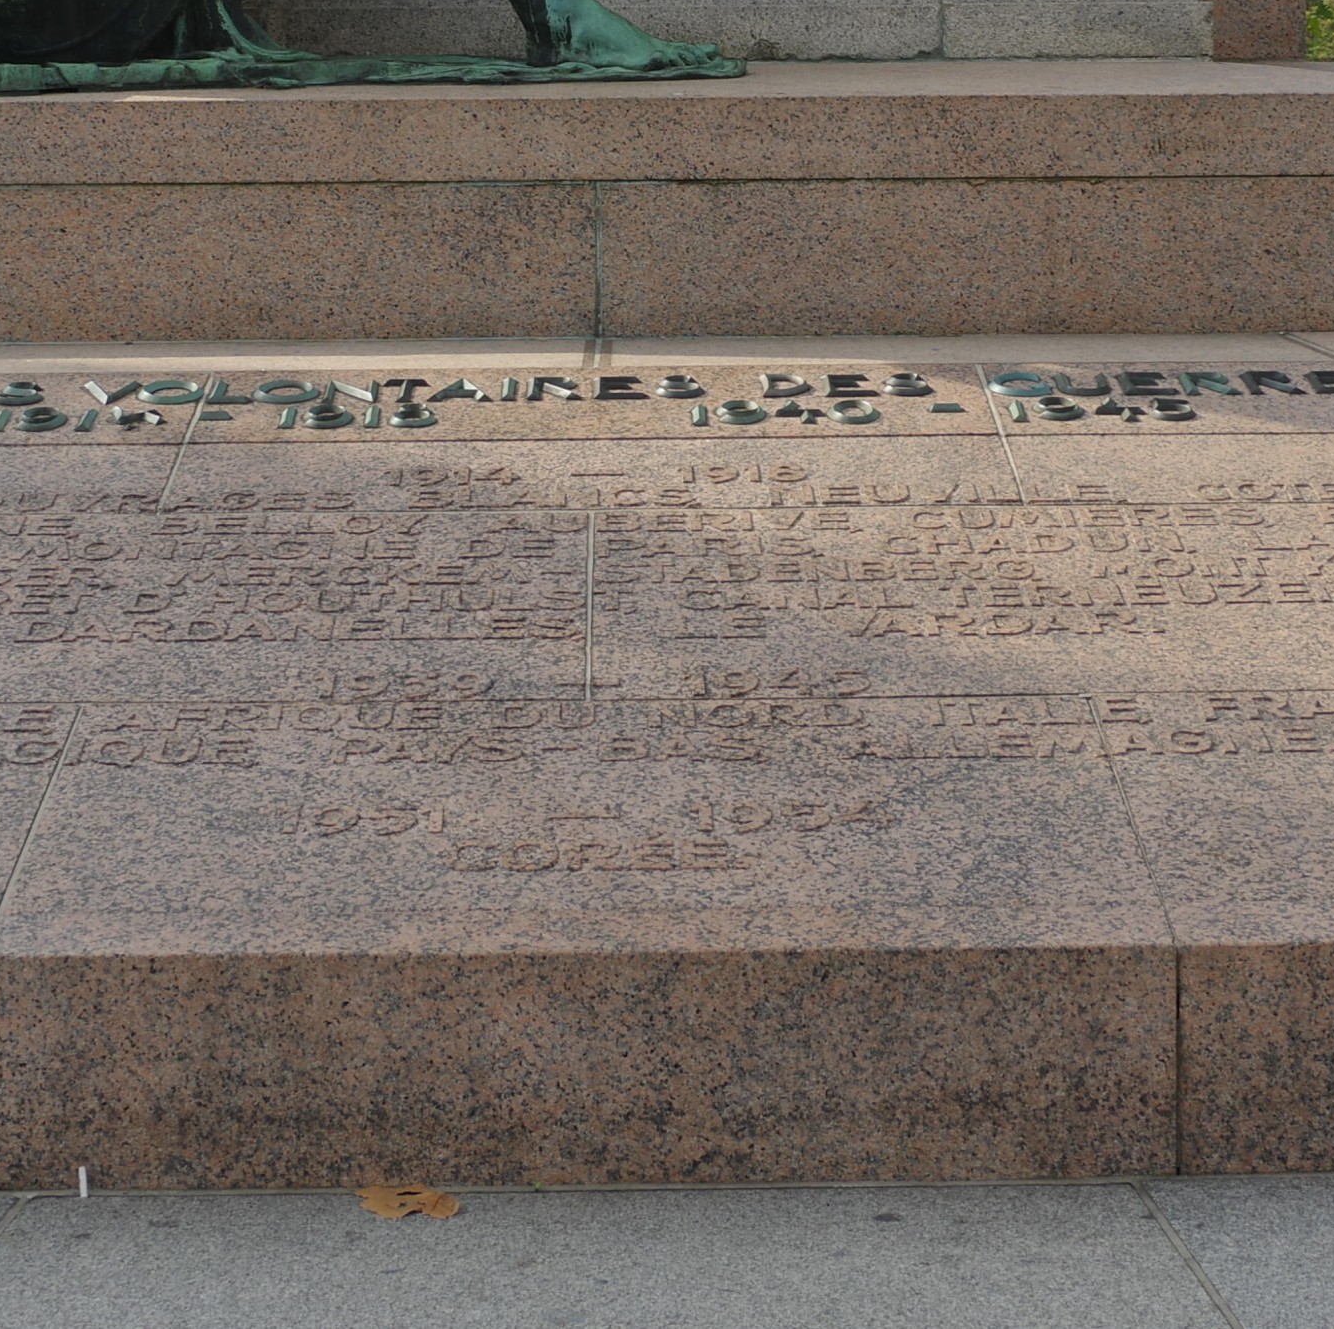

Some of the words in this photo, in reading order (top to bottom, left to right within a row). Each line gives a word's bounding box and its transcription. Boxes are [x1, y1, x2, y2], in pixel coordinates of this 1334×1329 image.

[80, 374, 709, 405] VOLONTAIRES
[760, 372, 934, 398] DES
[277, 402, 439, 430] 1918
[689, 399, 882, 427] 1940
[1005, 397, 1199, 423] 1945
[10, 540, 417, 562] MONTAGNE
[455, 539, 555, 559] DE
[659, 616, 769, 640] LE
[100, 706, 444, 733] AFRIQUE
[489, 703, 599, 730] DU
